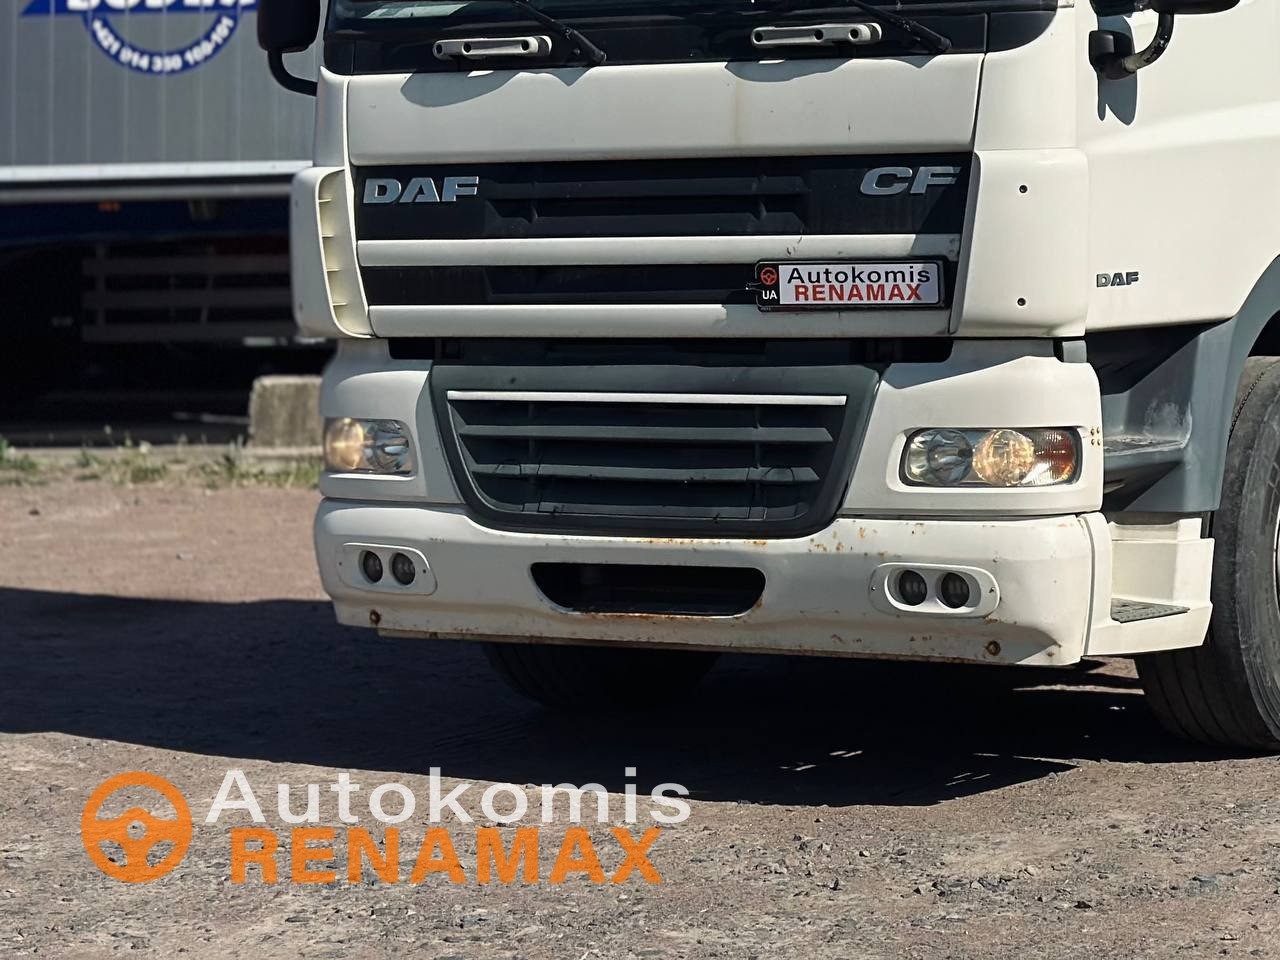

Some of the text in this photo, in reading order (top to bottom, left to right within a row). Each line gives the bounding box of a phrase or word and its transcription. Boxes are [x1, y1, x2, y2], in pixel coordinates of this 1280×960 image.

[860, 166, 961, 195] CF
[363, 176, 479, 203] DAF
[787, 266, 931, 283] Autokomis
[1096, 271, 1139, 288] DAF
[762, 290, 778, 300] UA
[794, 284, 922, 302] RENAMAX
